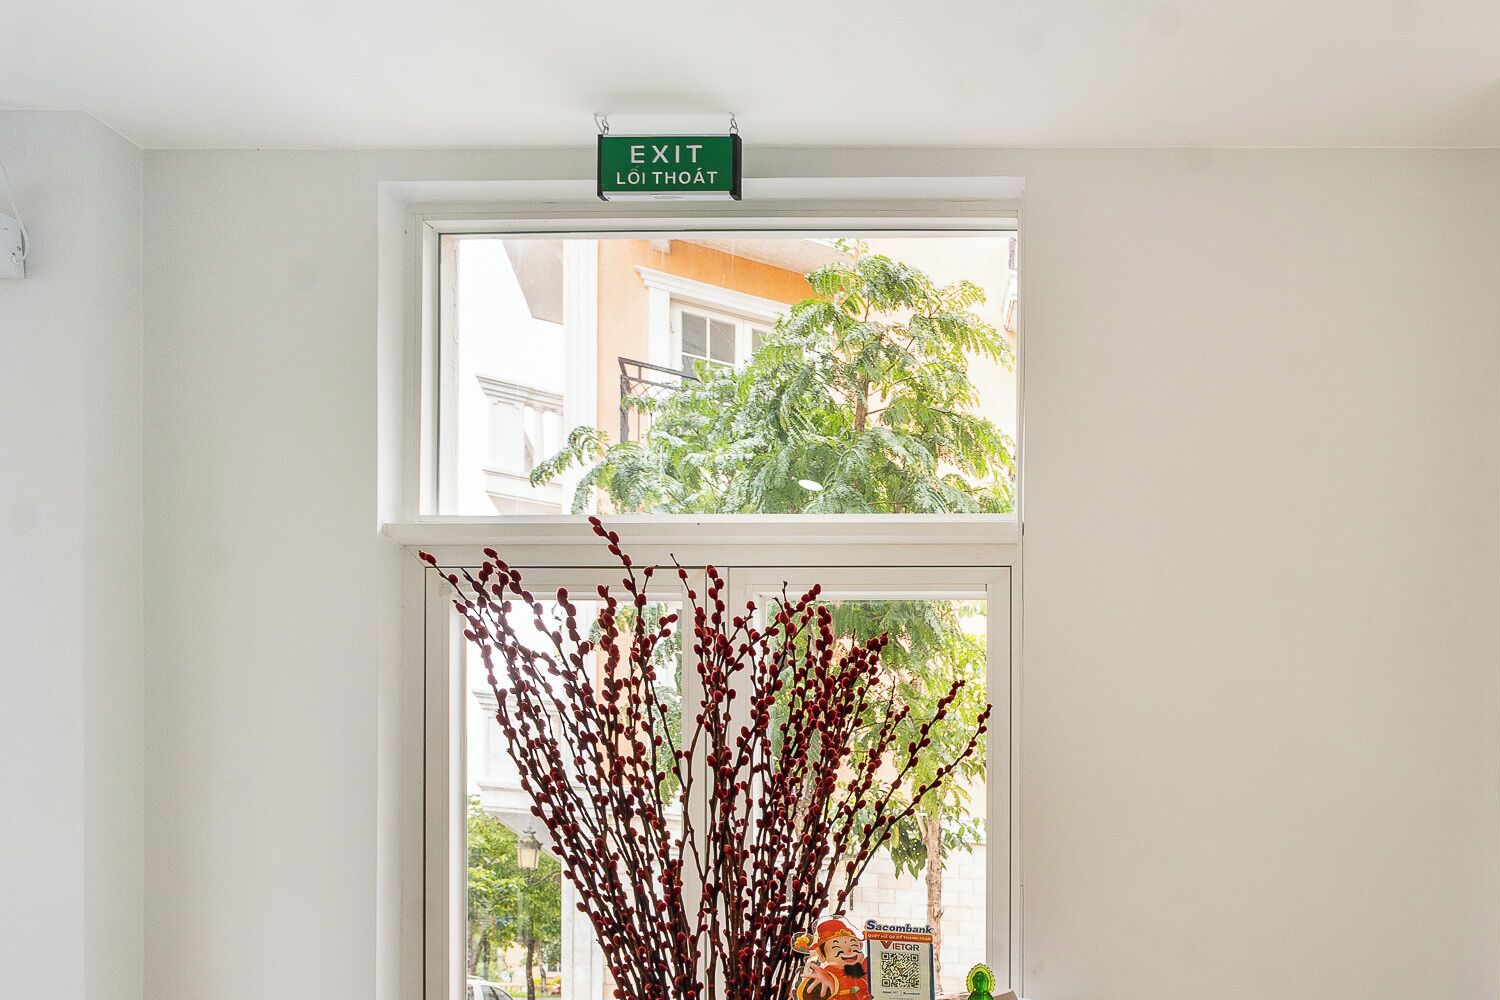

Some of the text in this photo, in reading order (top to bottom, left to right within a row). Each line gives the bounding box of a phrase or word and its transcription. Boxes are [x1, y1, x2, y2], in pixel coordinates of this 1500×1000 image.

[630, 144, 703, 164] EXIT
[616, 165, 718, 185] LỐI THOÁT
[866, 919, 933, 934] Sacombank
[880, 940, 920, 951] VIETQR
